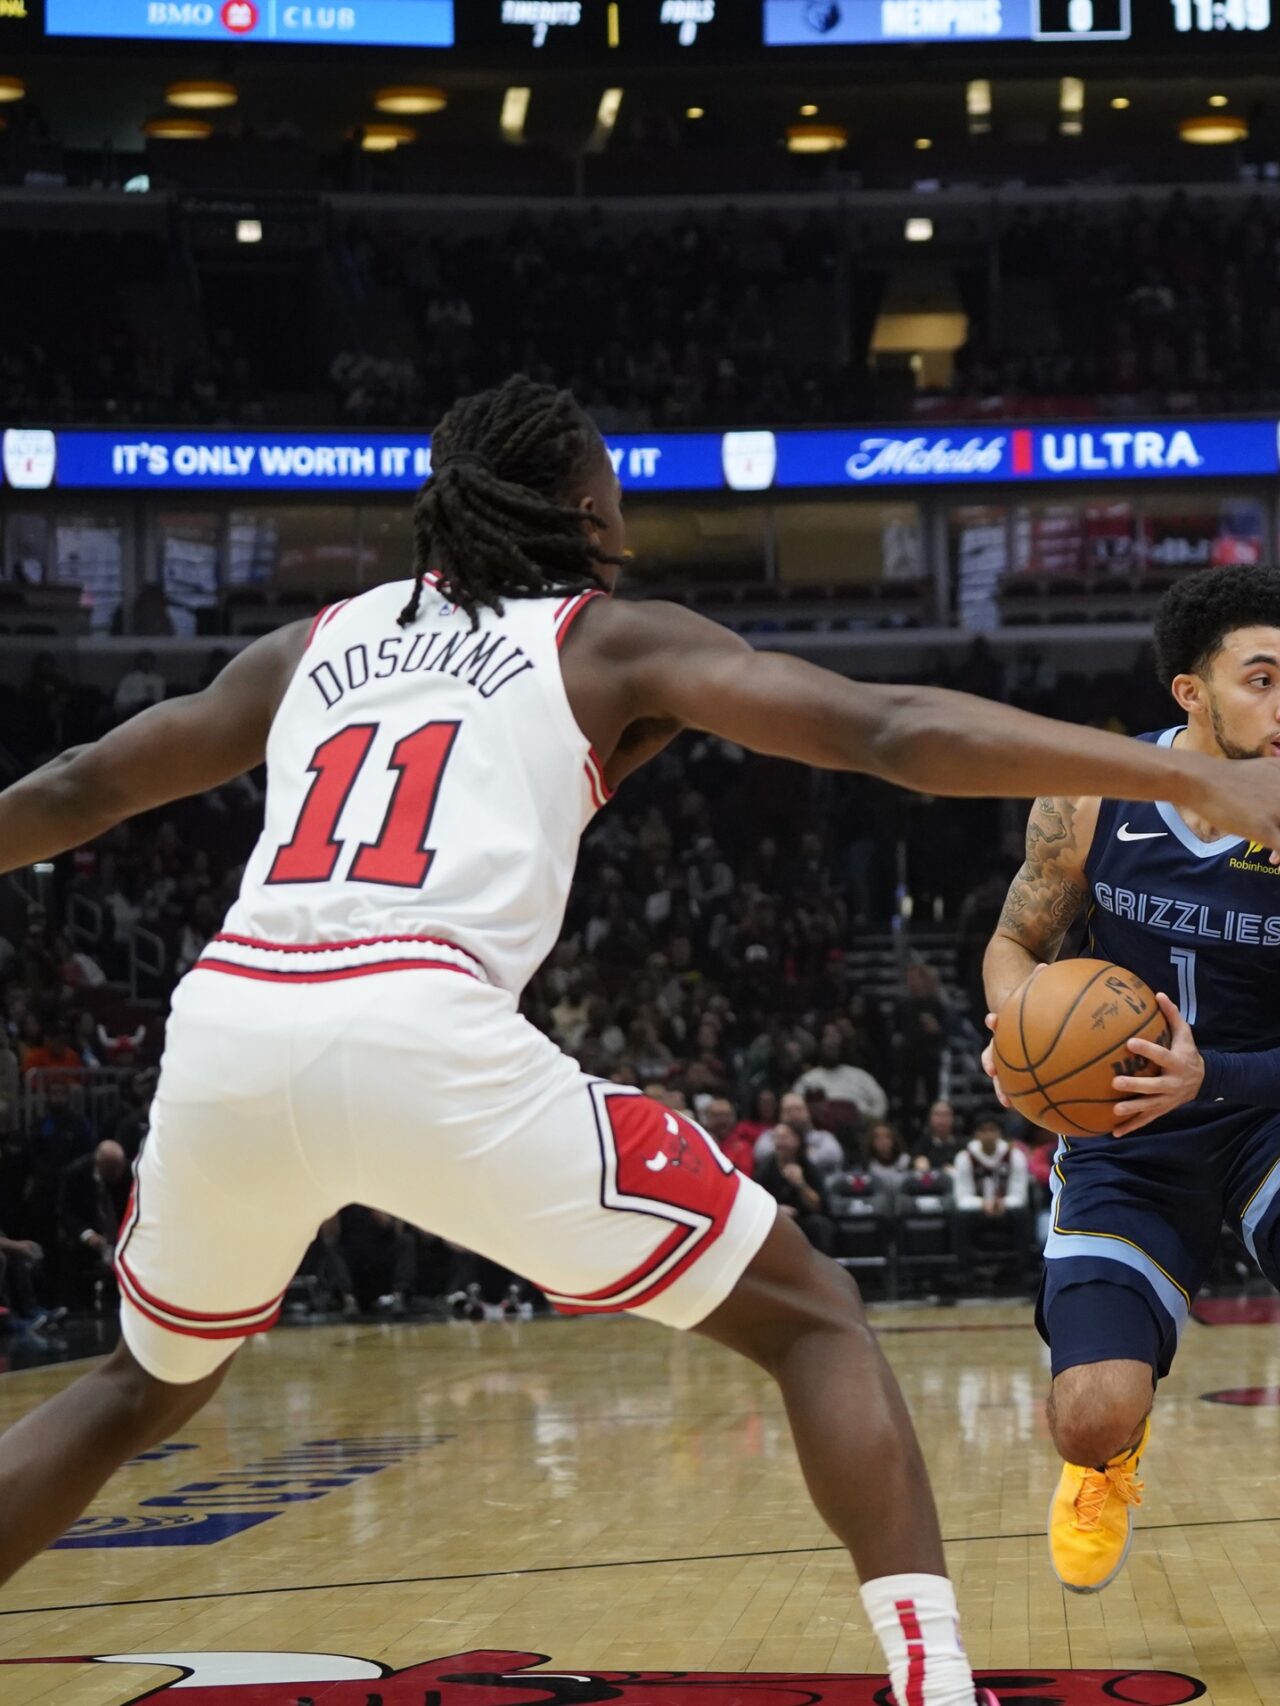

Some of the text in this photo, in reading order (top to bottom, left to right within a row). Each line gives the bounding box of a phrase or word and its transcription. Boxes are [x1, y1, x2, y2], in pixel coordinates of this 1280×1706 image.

[147, 2, 356, 31] BMO CLUB
[1170, 0, 1271, 32] 11:49
[112, 442, 169, 476] IT'S
[172, 445, 254, 476] ONLY
[259, 446, 375, 478] WORTH
[380, 447, 410, 477] IT
[629, 447, 662, 478] IT
[845, 430, 1201, 481] Michelob ULTRA
[308, 630, 535, 710] DOSUNMU
[263, 719, 463, 890] 11
[1229, 857, 1280, 875] Robinhood
[1170, 946, 1197, 1025] 1
